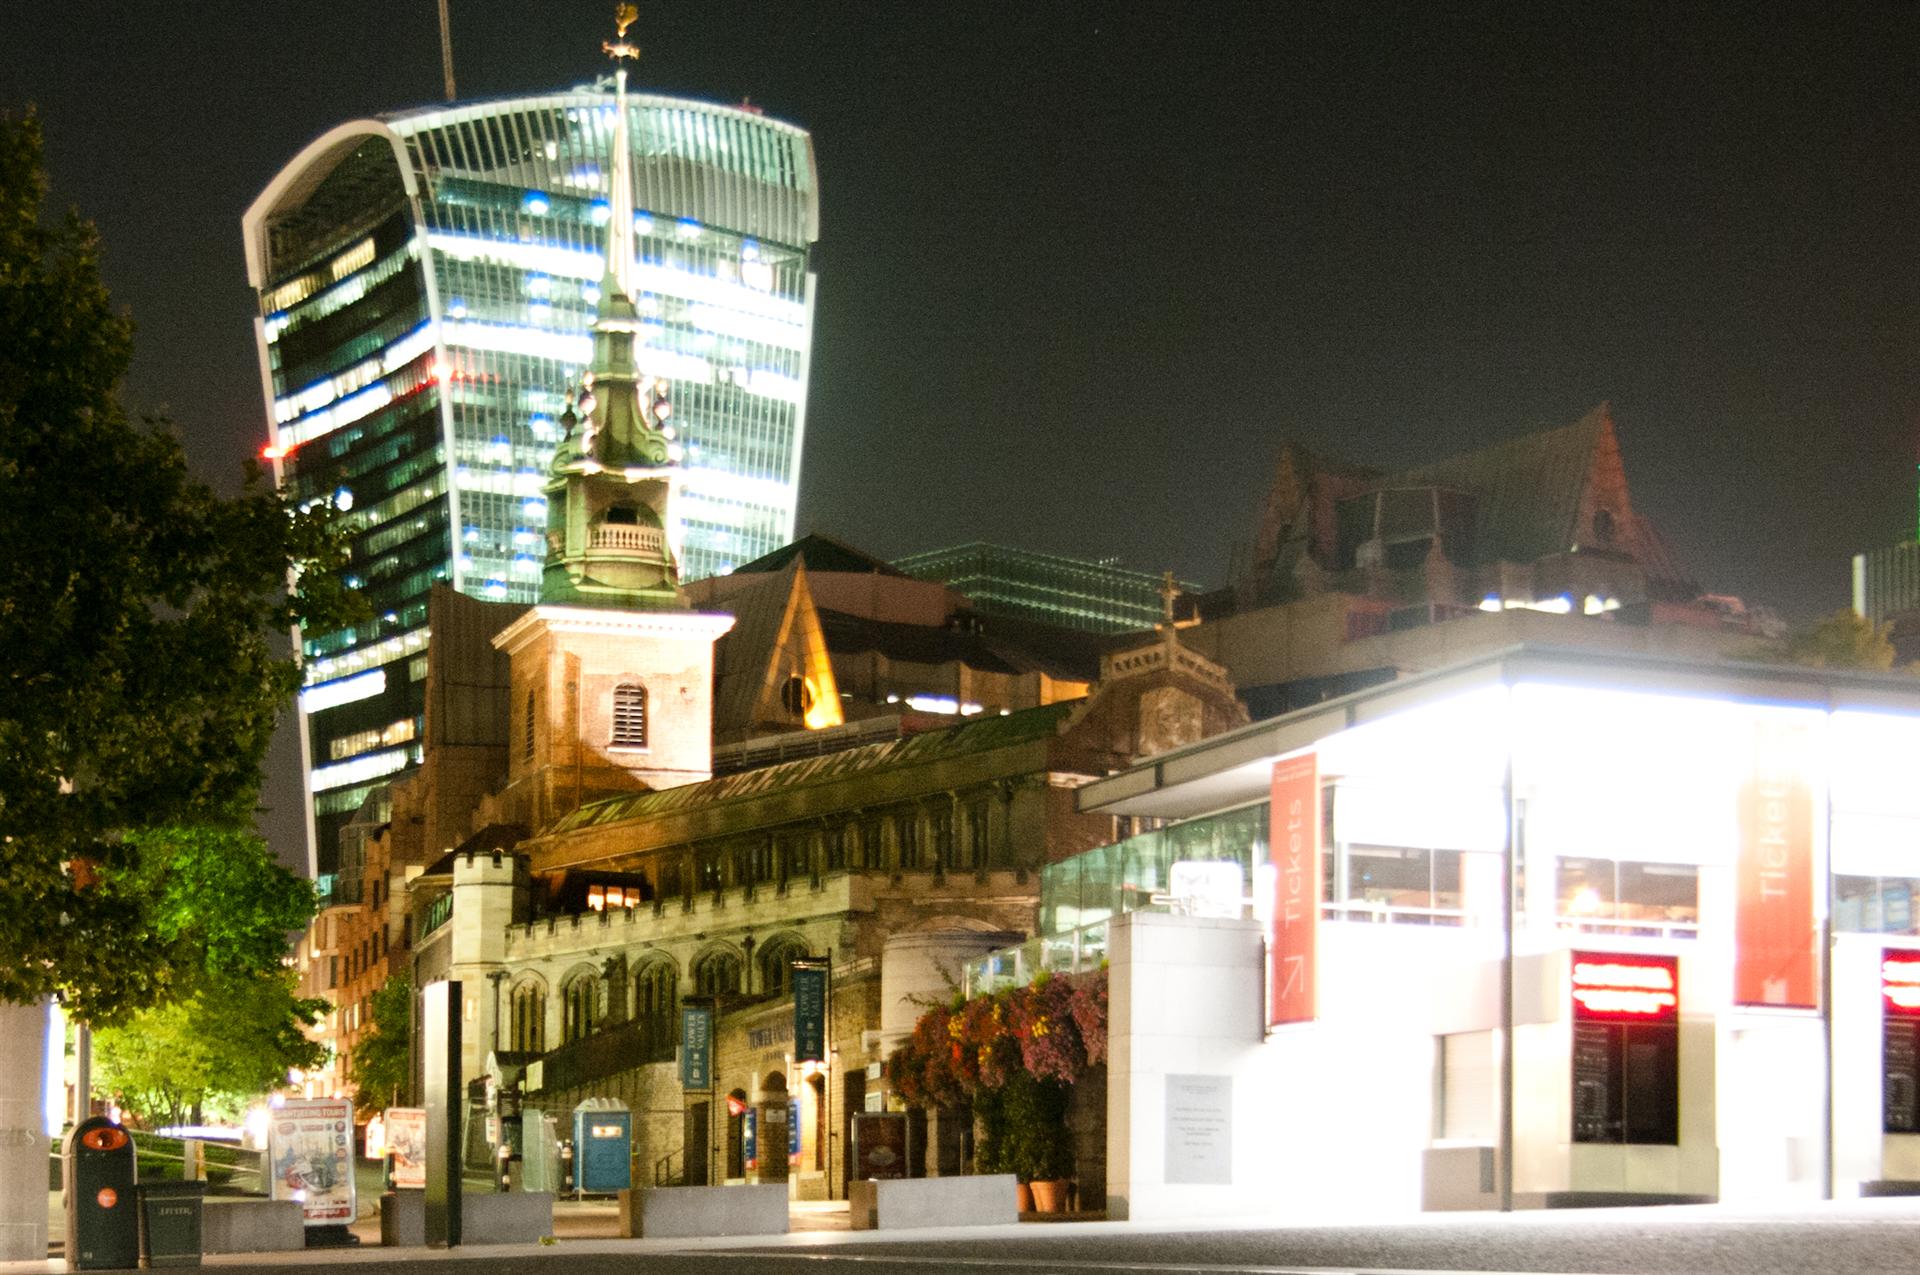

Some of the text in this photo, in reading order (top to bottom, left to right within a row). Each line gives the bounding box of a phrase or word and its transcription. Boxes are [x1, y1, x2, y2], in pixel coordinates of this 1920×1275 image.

[1760, 766, 1788, 903] Ticket
[1284, 799, 1303, 928] Tickets
[800, 977, 809, 1016] TOWER
[810, 975, 820, 1017] VAULTS
[688, 1014, 697, 1049] TOWER
[697, 1014, 706, 1049] VAULTS
